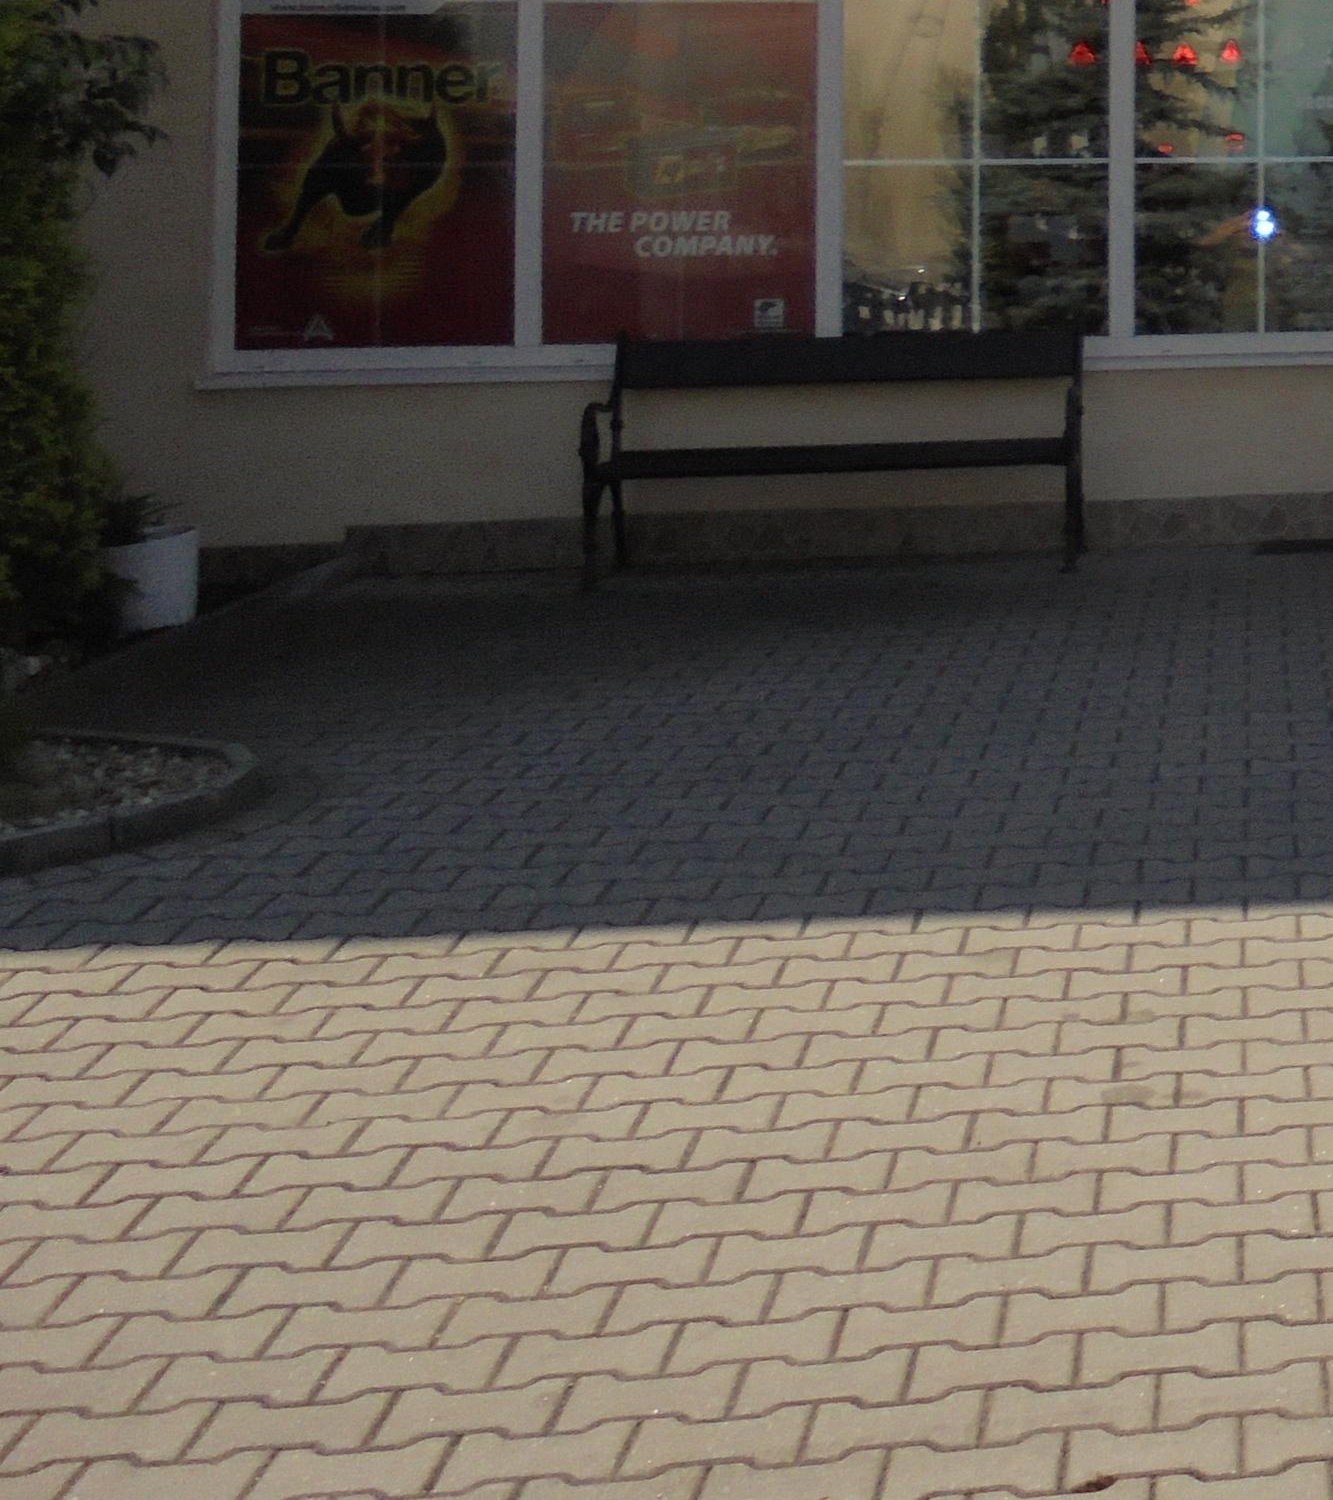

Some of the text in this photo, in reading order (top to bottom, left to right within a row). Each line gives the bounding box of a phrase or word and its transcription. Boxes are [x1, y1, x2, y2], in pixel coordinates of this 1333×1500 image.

[264, 50, 501, 103] Banner
[571, 211, 733, 232] THE POWER
[636, 235, 779, 257] COMPANY.
